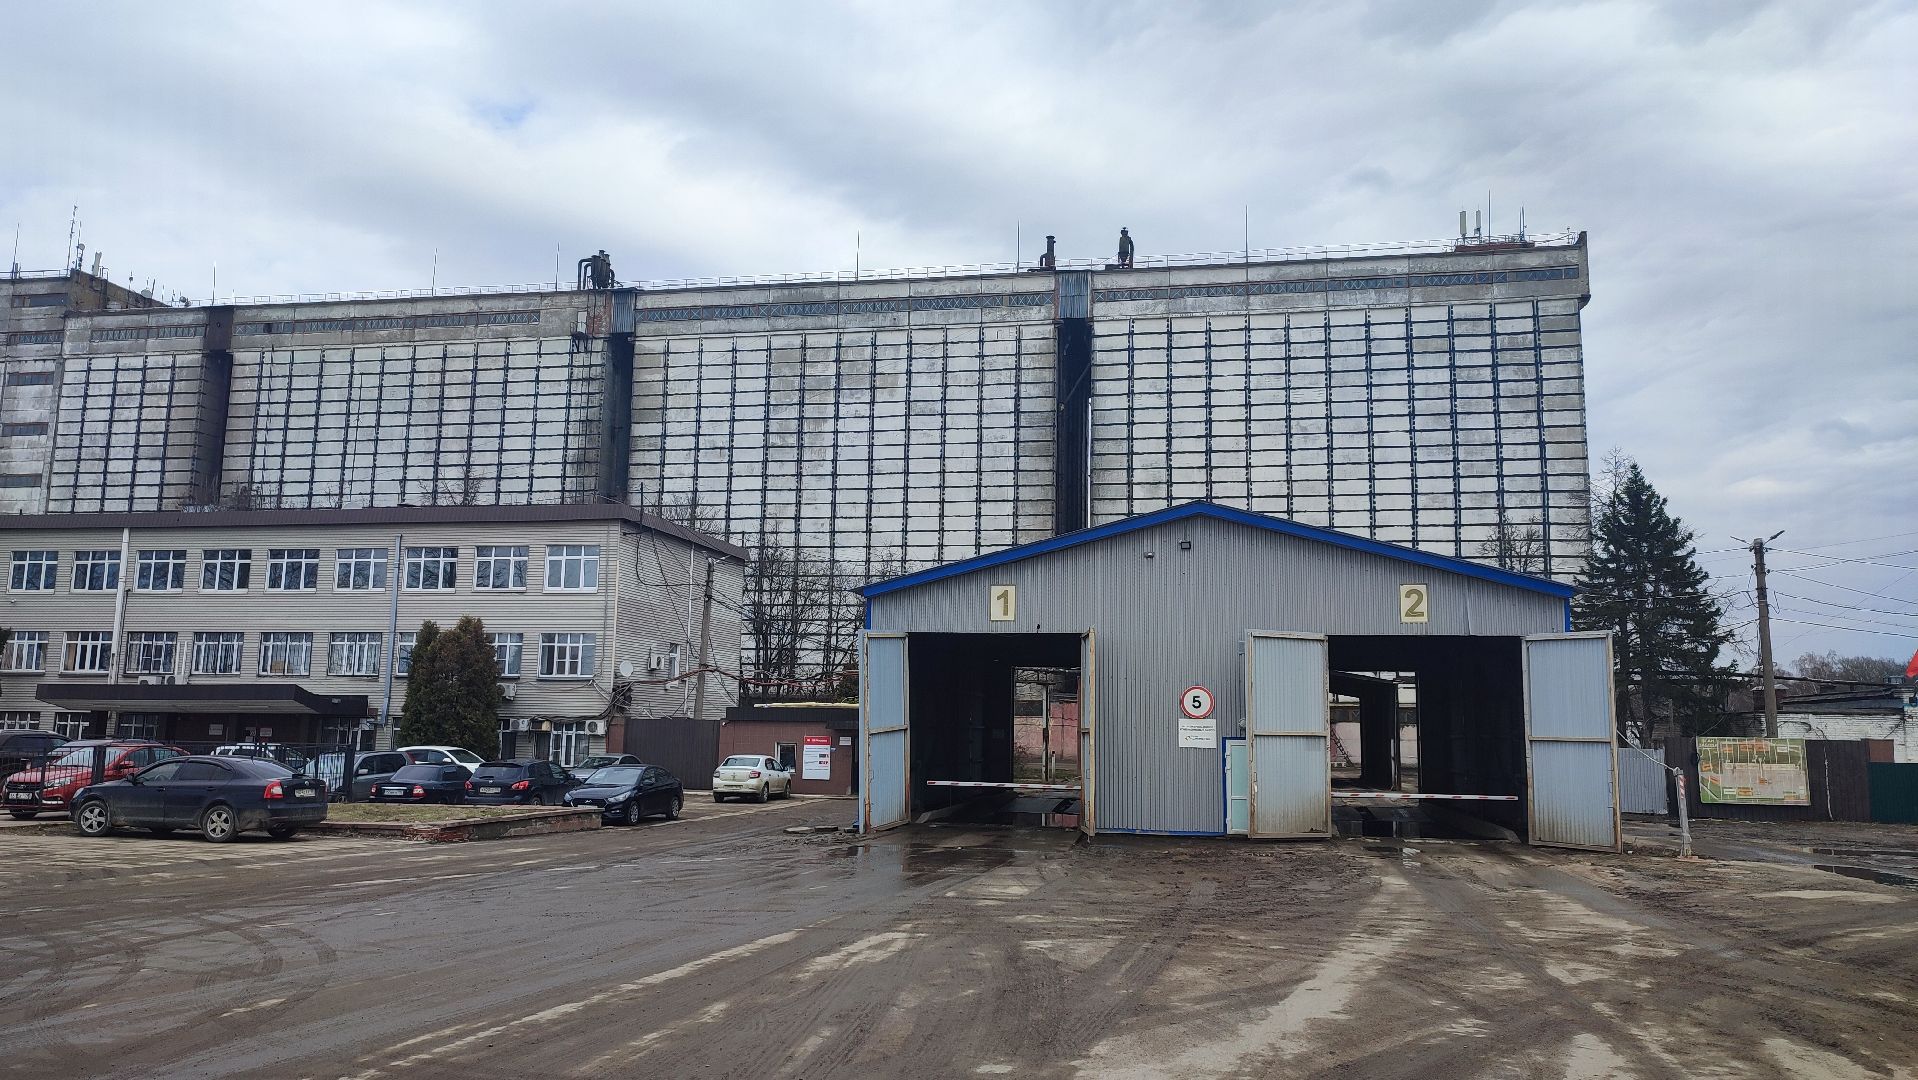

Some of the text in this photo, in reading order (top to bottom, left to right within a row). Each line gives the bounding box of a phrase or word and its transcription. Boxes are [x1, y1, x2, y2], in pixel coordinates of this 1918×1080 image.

[996, 589, 1009, 617] 1
[1404, 588, 1425, 618] 2
[1191, 695, 1202, 709] 5
